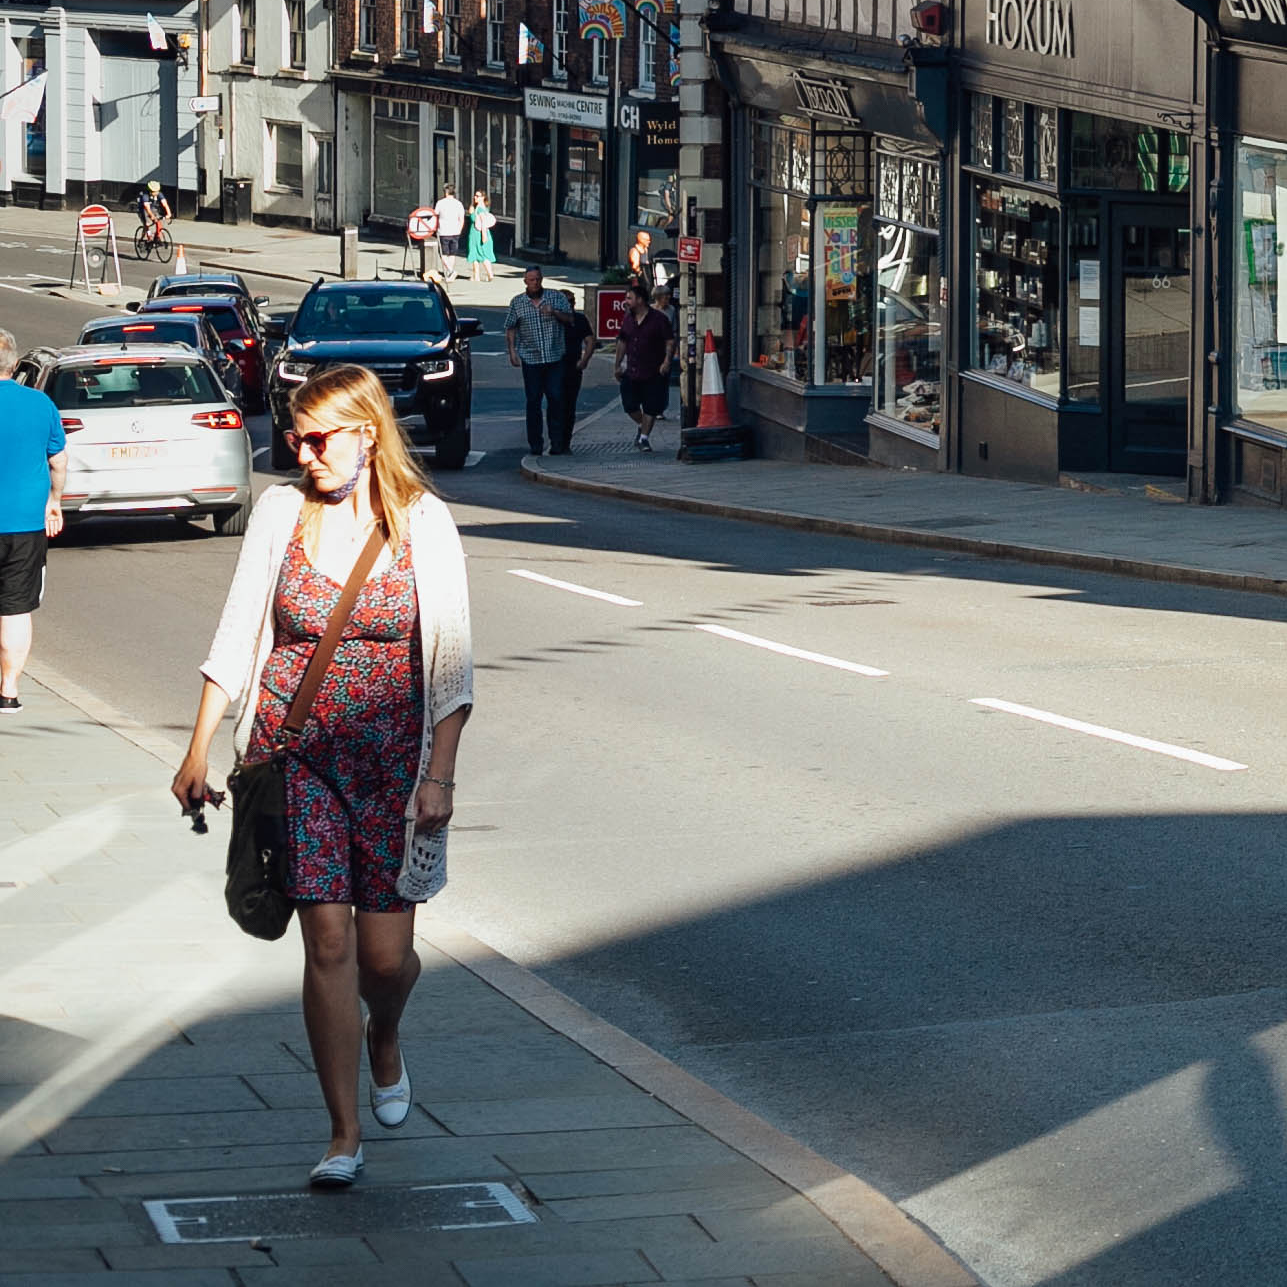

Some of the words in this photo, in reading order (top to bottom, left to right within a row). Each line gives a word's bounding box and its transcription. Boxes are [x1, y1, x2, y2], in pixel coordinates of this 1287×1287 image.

[528, 93, 556, 109] SEWING
[576, 100, 603, 115] CENTRE
[646, 120, 677, 133] Wyld
[1152, 274, 1171, 289] 66
